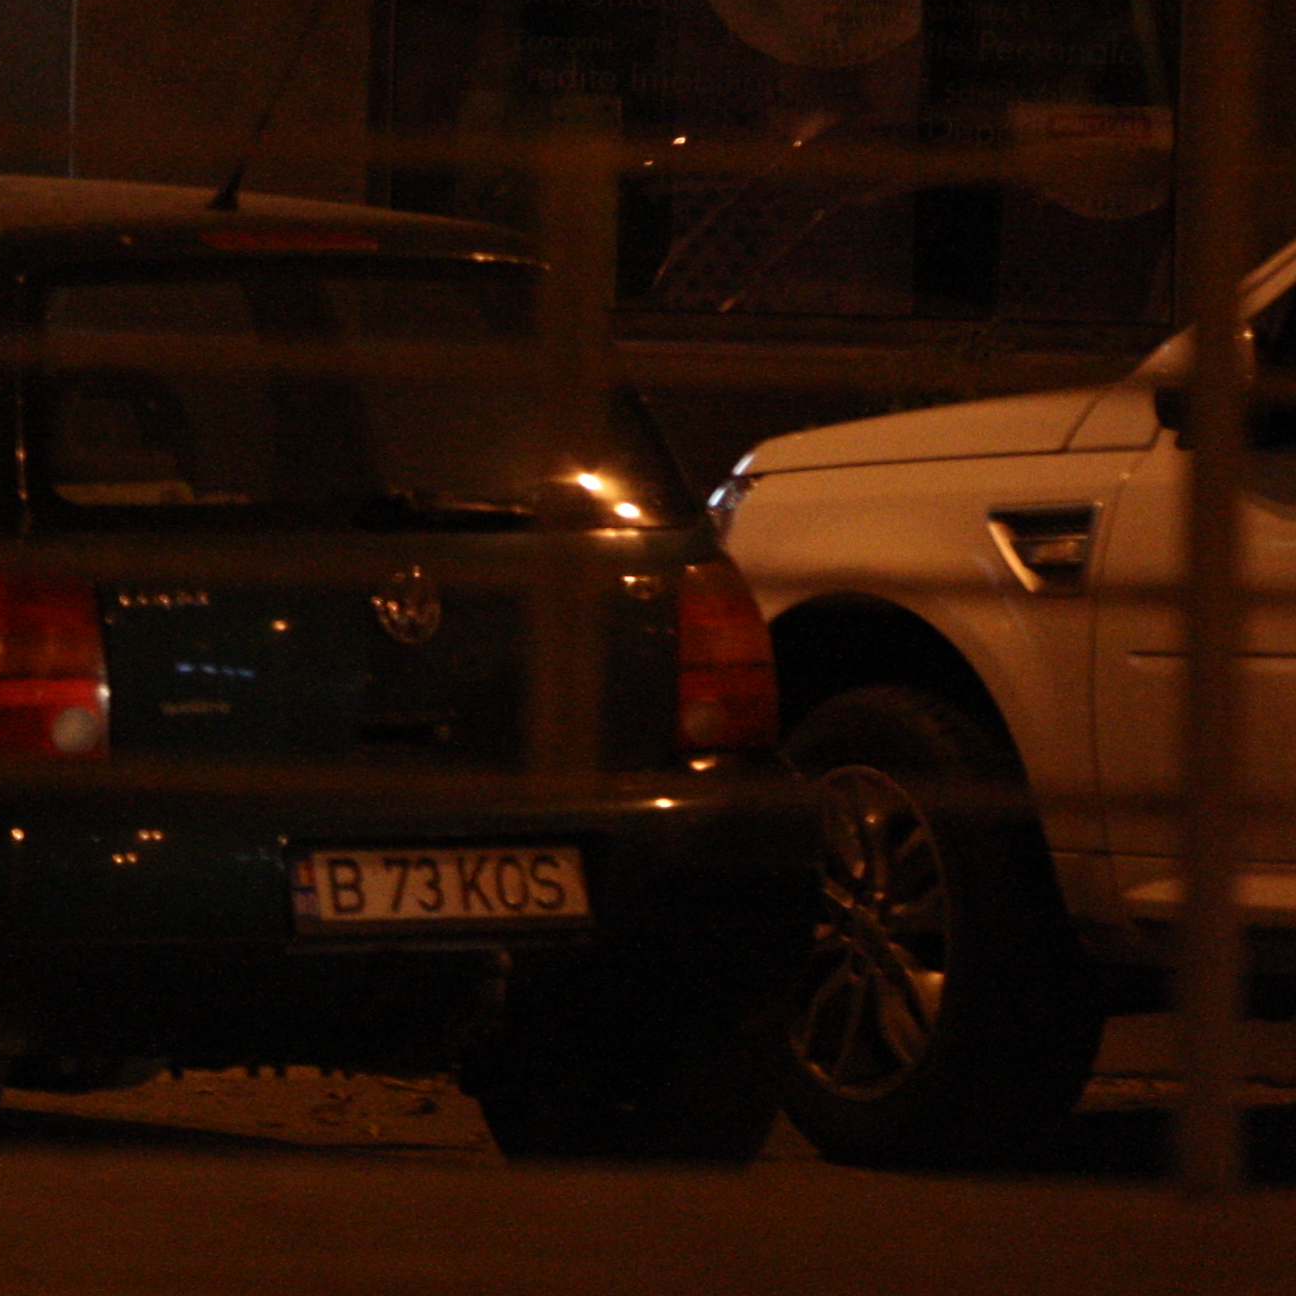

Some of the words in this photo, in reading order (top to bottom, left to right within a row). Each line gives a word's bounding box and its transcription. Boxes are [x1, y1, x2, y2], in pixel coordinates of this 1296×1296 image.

[327, 856, 363, 914] B
[384, 855, 444, 913] 73
[457, 854, 565, 911] KOS
